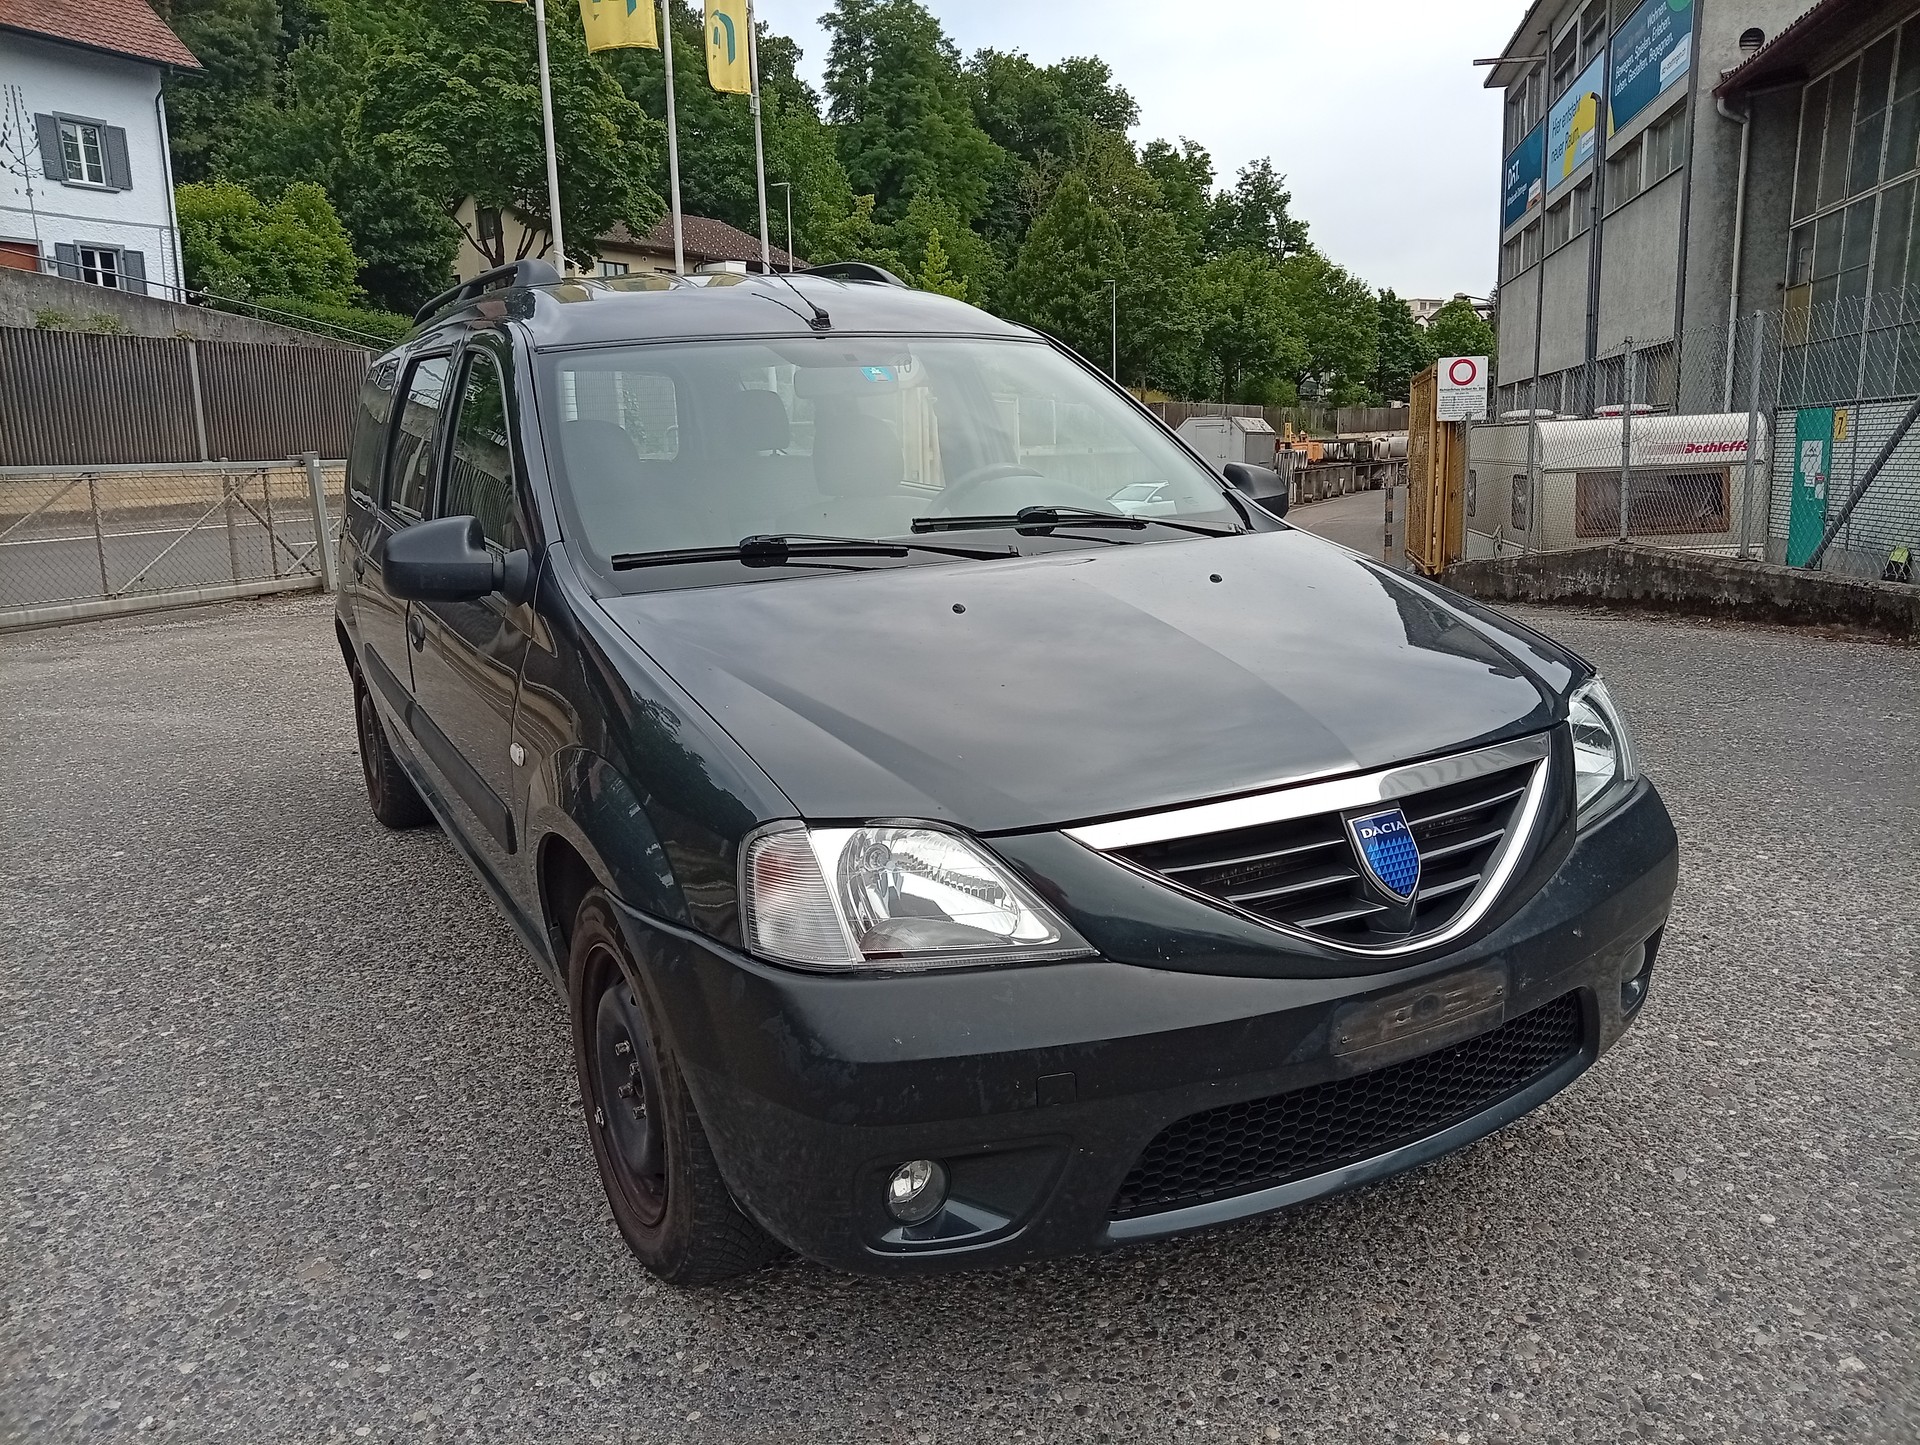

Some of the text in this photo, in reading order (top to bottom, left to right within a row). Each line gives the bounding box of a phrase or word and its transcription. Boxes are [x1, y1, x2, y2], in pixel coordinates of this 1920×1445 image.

[1615, 54, 1634, 79] Bewegen.
[1634, 36, 1651, 61] Spielen.
[1552, 117, 1562, 139] Hier
[1551, 141, 1564, 164] neuer
[1684, 440, 1748, 454] Dethleffs
[1360, 821, 1406, 839] DACIA
